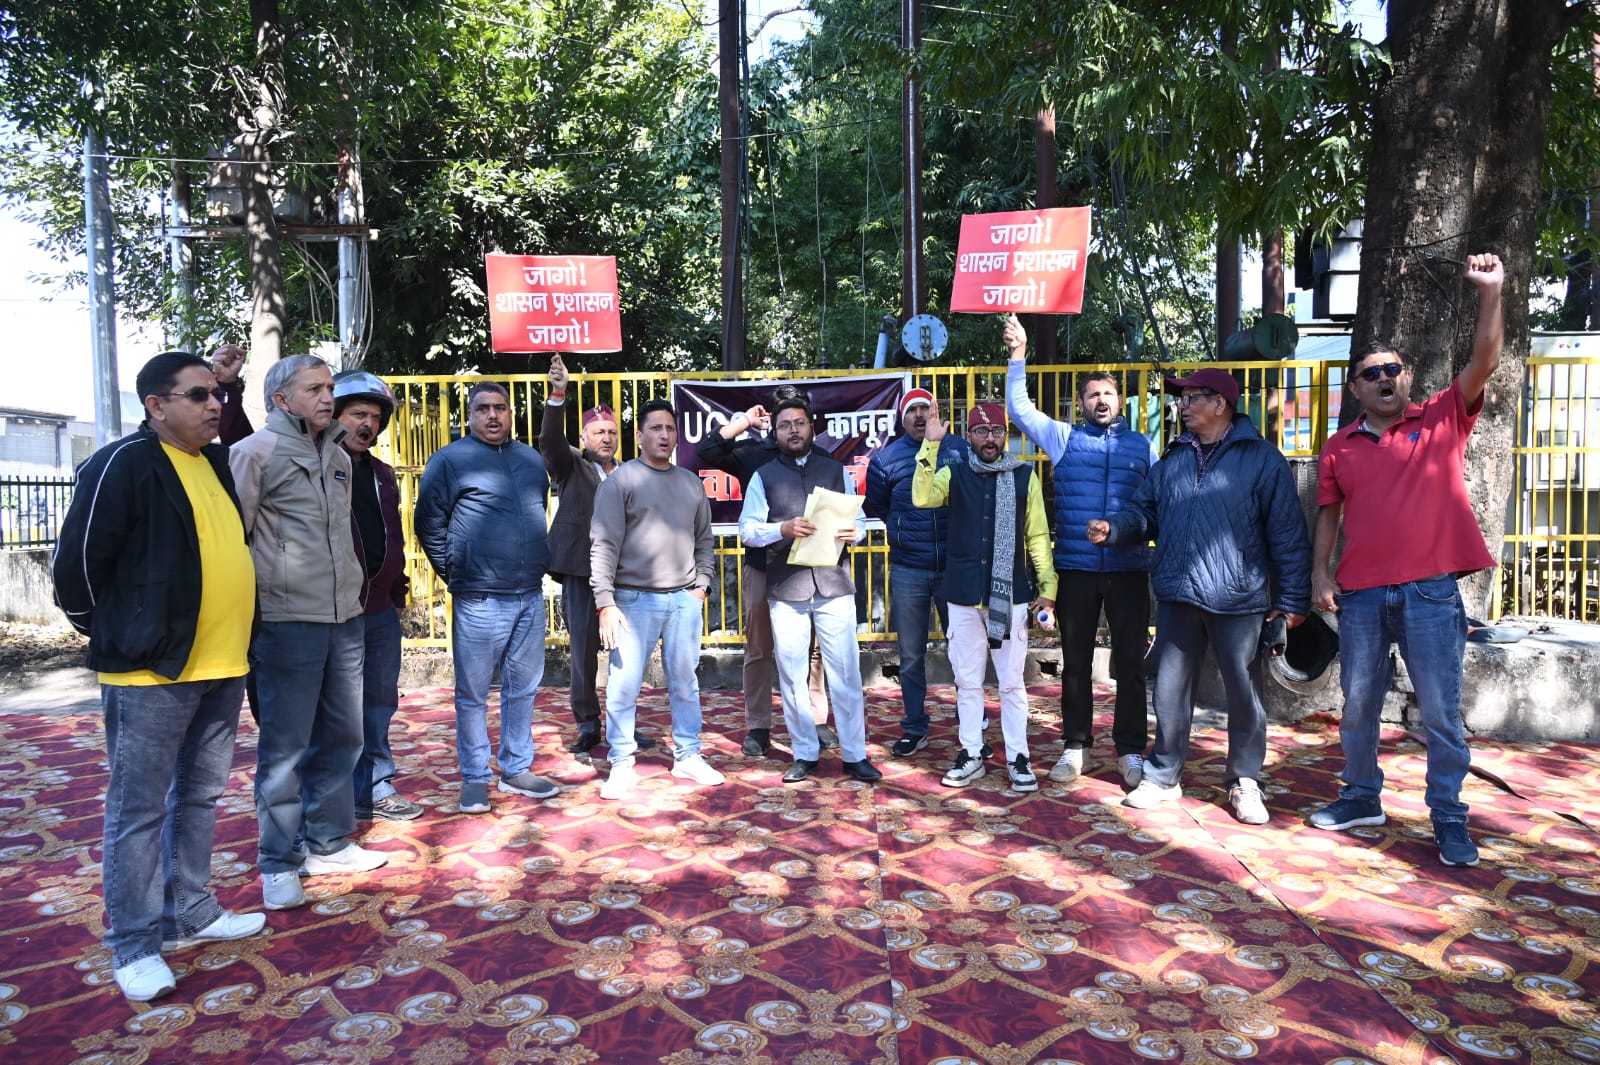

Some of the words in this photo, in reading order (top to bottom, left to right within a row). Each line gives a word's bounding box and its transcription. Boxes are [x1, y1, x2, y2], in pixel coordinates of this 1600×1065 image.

[990, 215, 1052, 245] जागो!
[522, 260, 587, 286] जागो!
[960, 252, 1009, 273] शासन
[1013, 250, 1079, 276] प्रशासन
[495, 292, 548, 313] शासन
[552, 292, 614, 316] प्रशासन
[983, 278, 1046, 307] जागो!
[527, 318, 590, 344] जागो!
[824, 409, 897, 448] कानून
